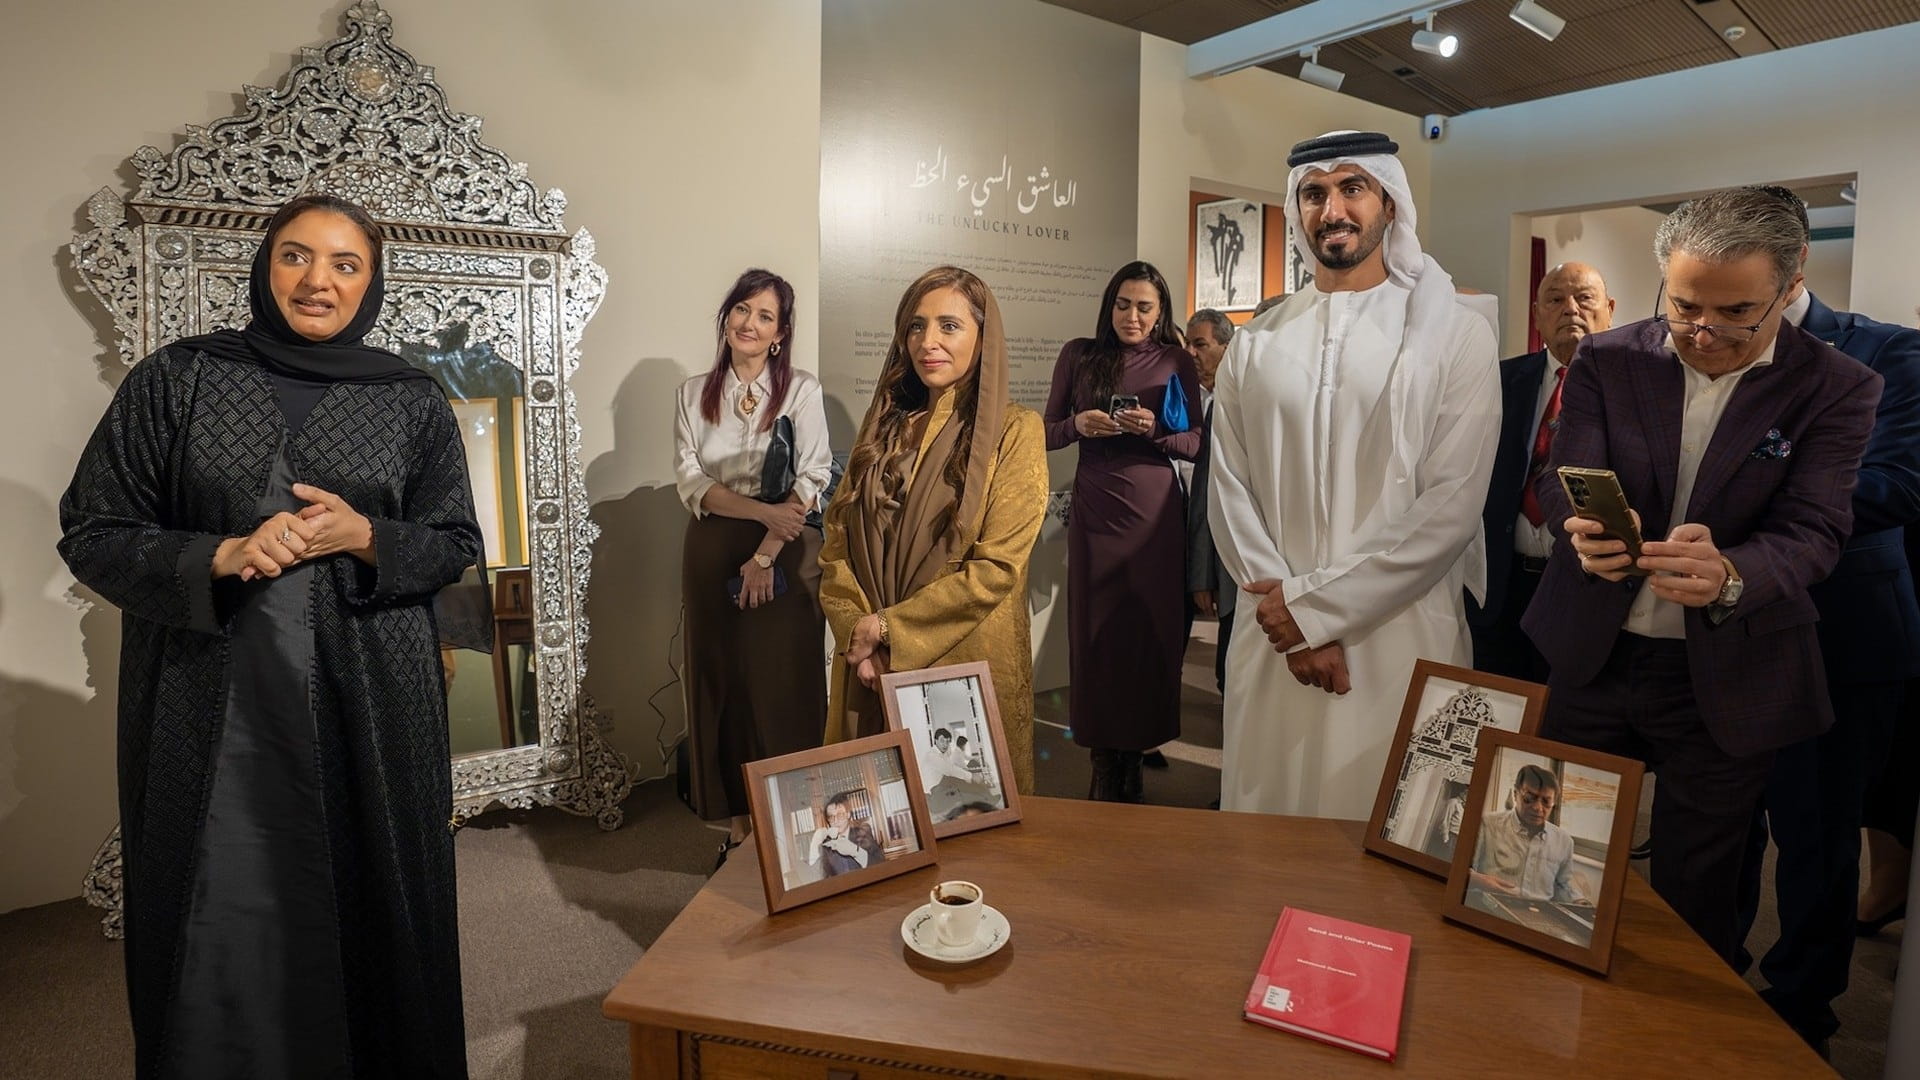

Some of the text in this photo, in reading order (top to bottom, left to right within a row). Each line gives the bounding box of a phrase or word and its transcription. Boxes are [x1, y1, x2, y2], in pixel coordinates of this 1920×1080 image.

[910, 144, 1077, 216] العاشق السيء الحظ
[914, 211, 1071, 242] THE UNLUCKY LOVER
[1308, 926, 1327, 935] Sand
[1344, 935, 1365, 944] Other
[1367, 941, 1394, 951] Poems
